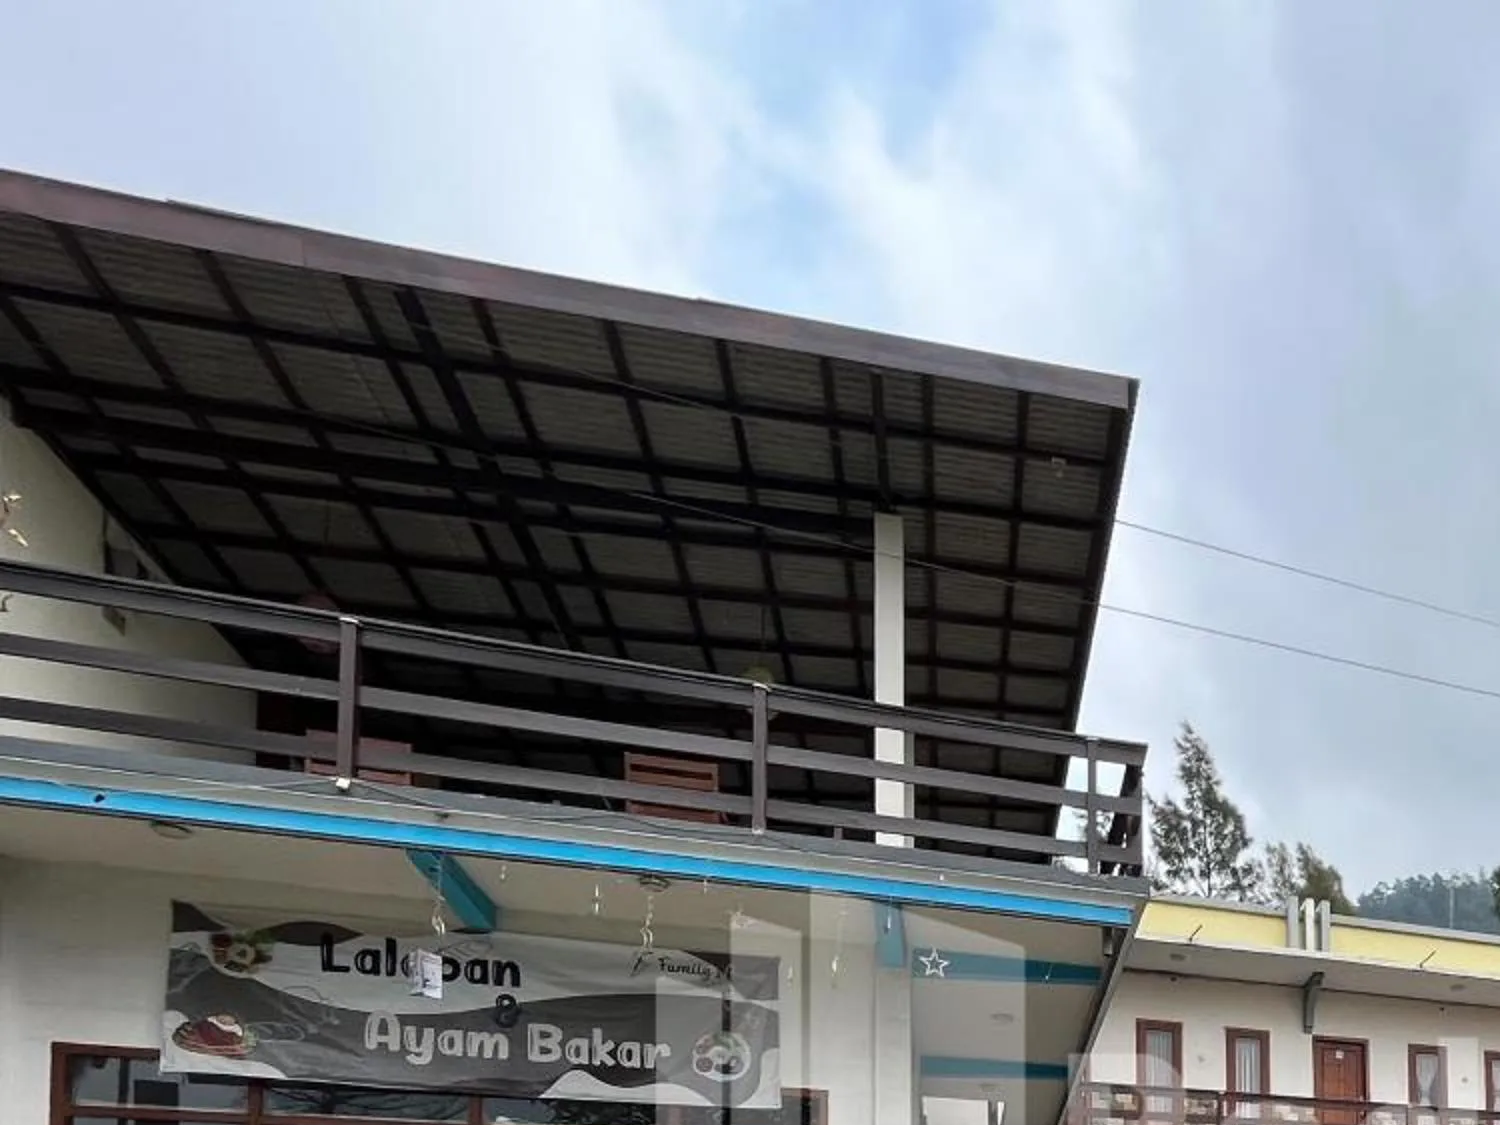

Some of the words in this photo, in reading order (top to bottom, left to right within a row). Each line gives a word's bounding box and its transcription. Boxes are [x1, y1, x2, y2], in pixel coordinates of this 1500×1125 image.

[319, 932, 521, 988] Lalpan
[364, 1010, 509, 1065] Ayam
[526, 1022, 672, 1069] Bakar
